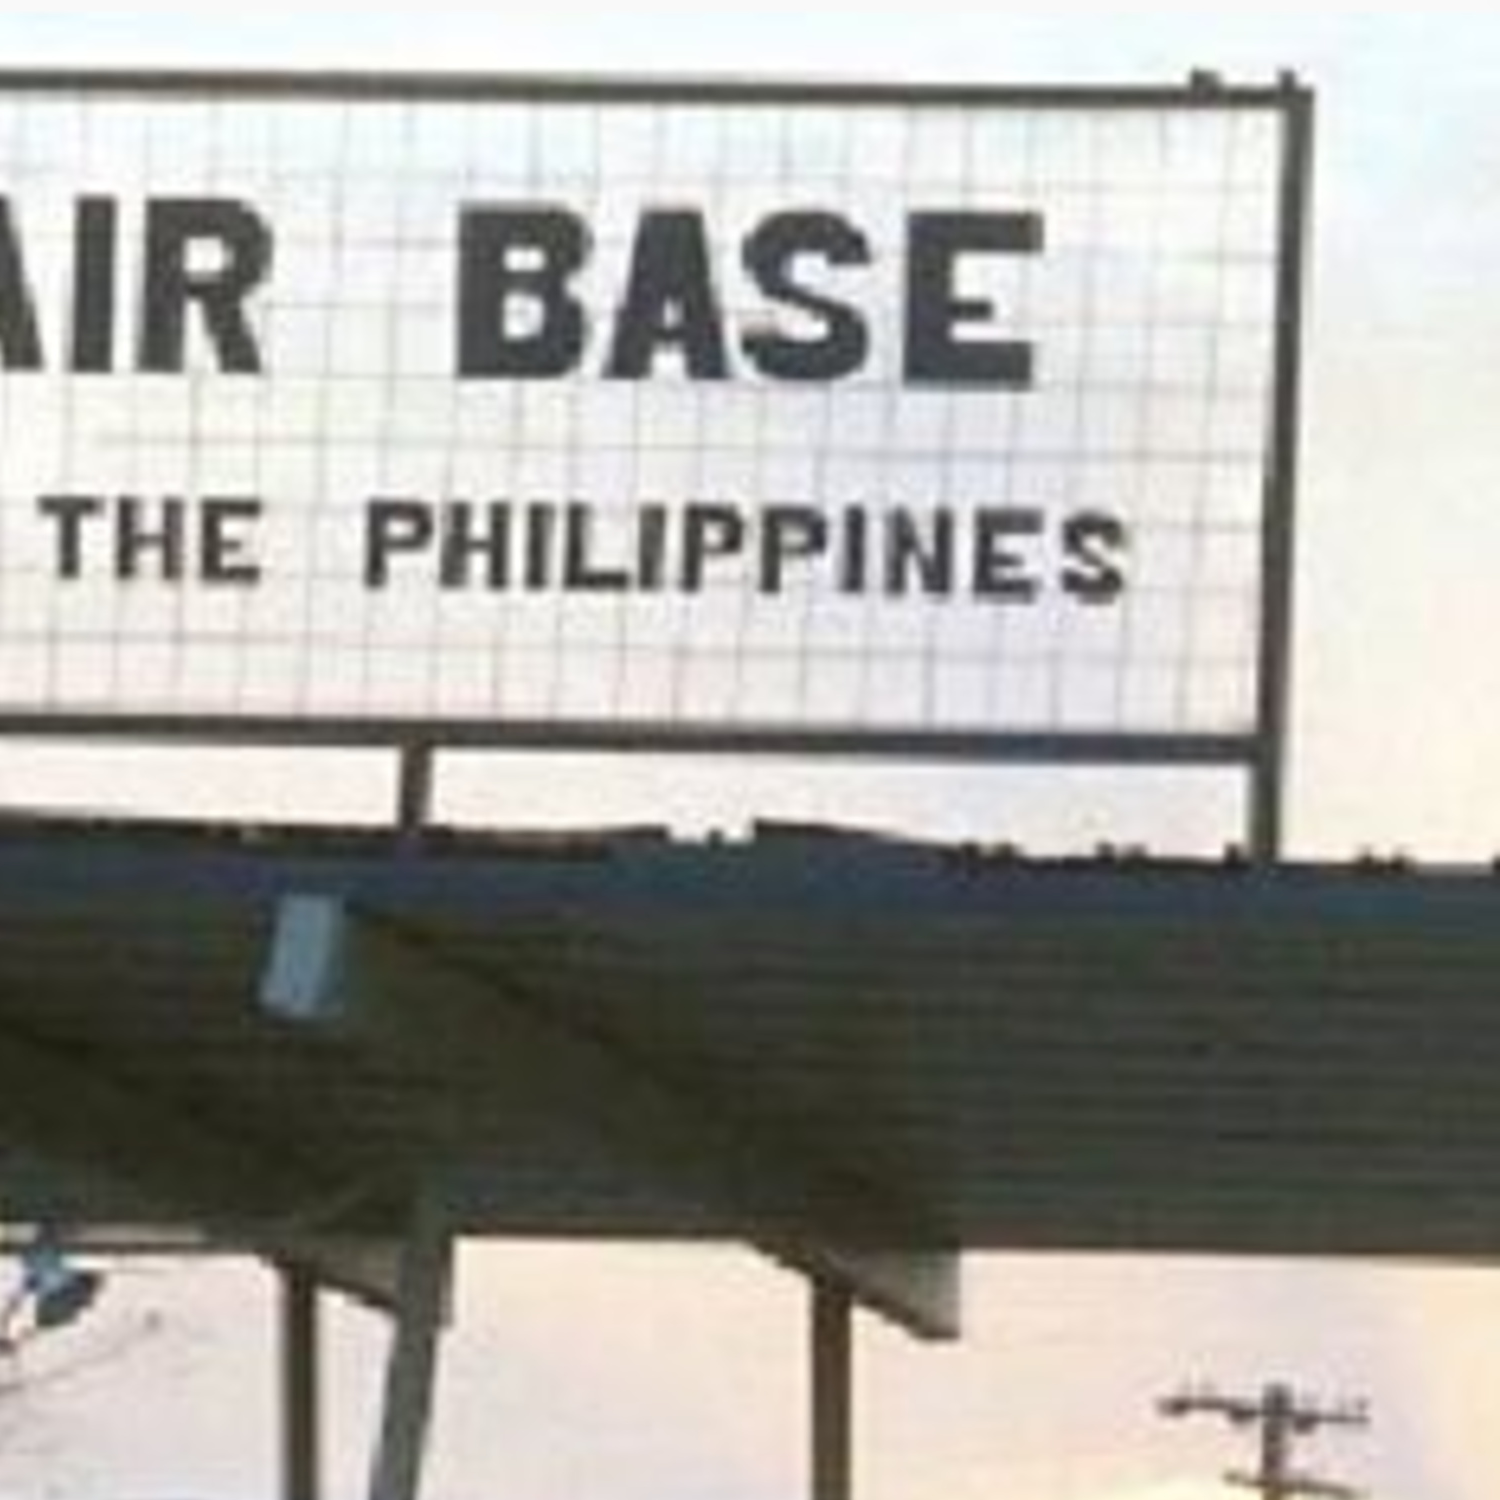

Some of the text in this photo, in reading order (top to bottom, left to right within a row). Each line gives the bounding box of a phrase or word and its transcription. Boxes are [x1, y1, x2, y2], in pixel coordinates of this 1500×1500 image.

[455, 207, 1044, 392] BASE
[38, 494, 263, 585] THE
[363, 500, 1126, 605] PHILIPPINES
